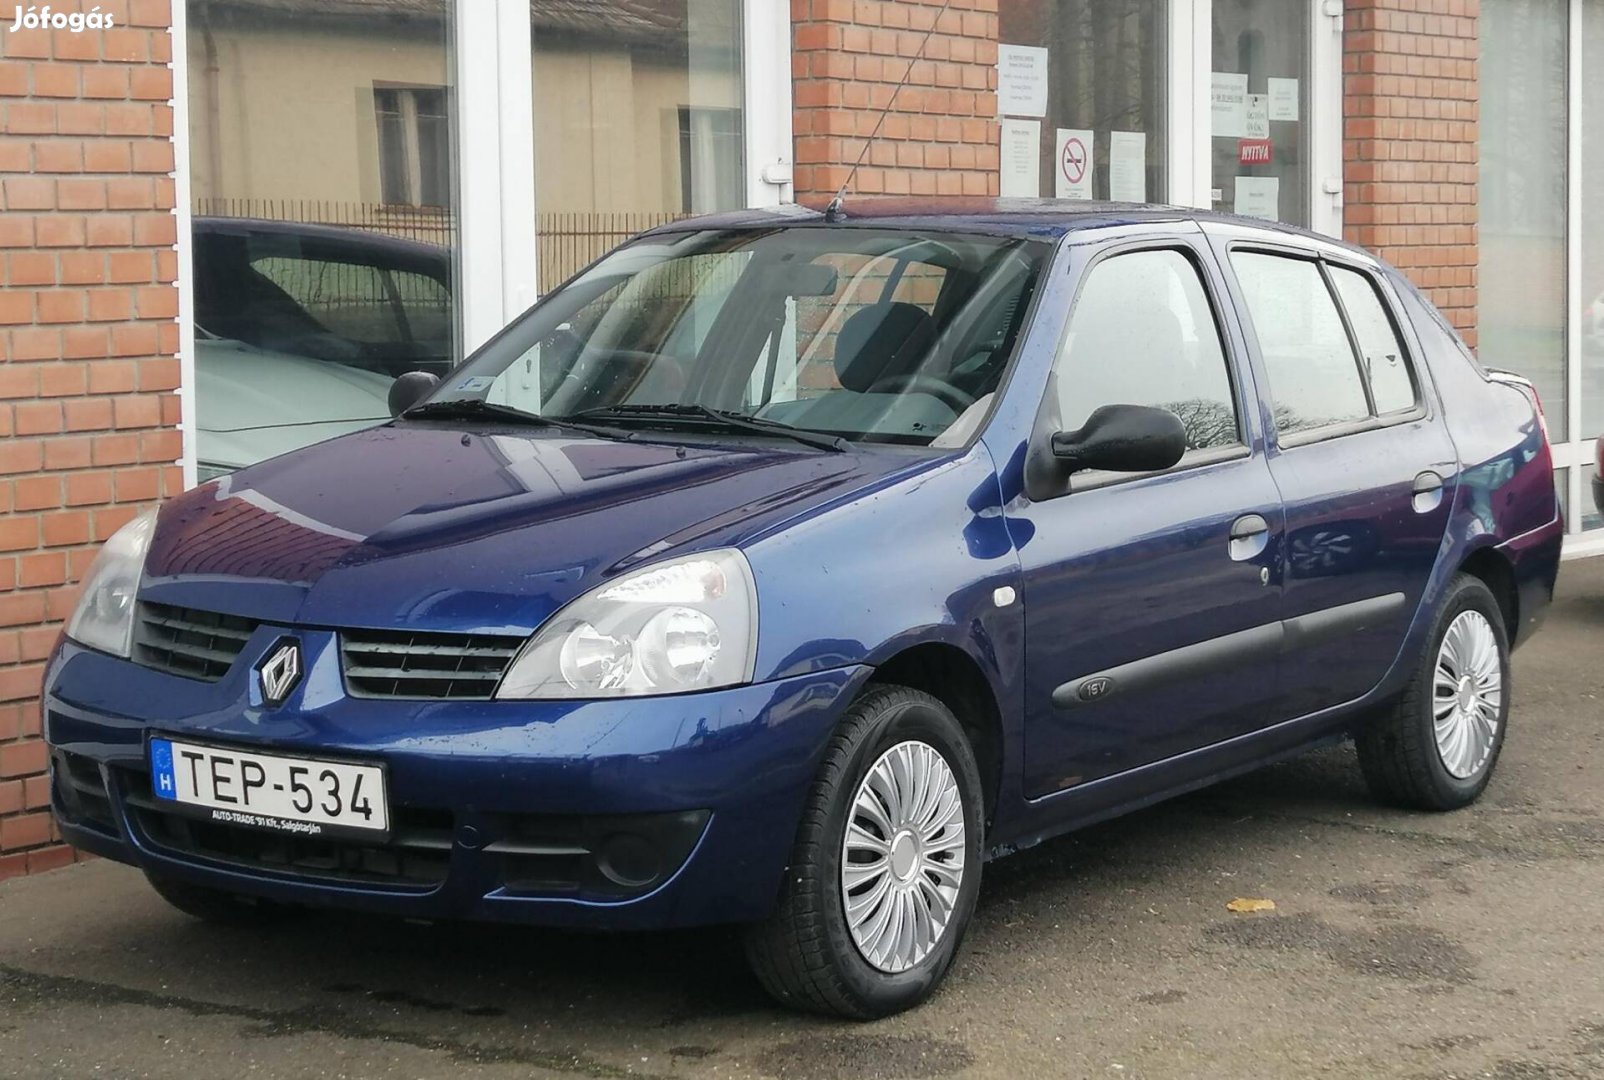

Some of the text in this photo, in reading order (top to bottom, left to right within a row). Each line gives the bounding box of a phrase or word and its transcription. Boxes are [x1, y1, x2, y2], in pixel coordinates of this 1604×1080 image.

[1241, 145, 1269, 160] NYITVA
[160, 773, 171, 790] H
[181, 750, 372, 821] TEP-534
[212, 809, 255, 825] AUTO-TRADE
[281, 820, 321, 835] Salgótarján
